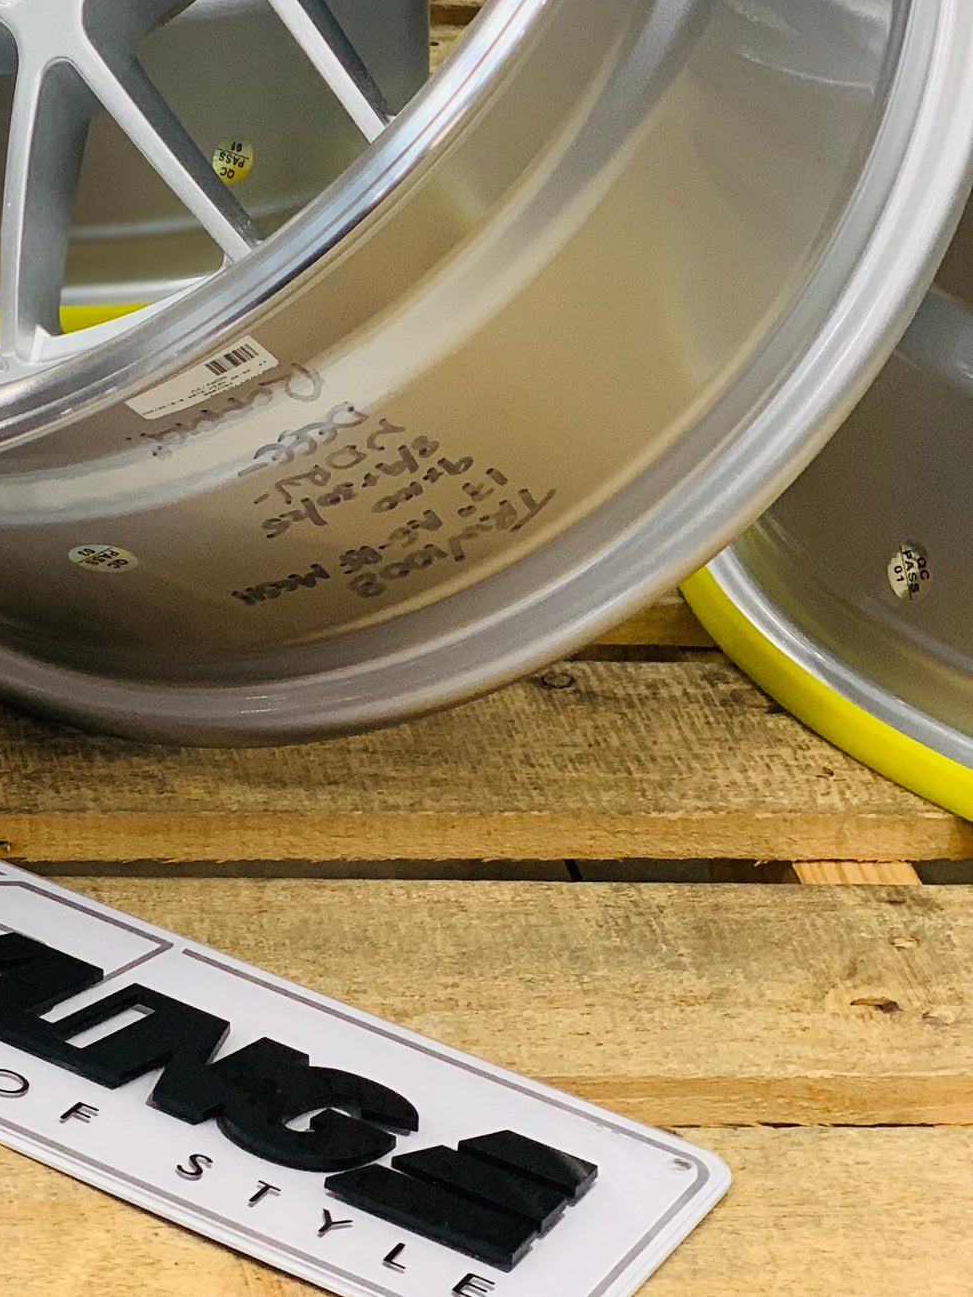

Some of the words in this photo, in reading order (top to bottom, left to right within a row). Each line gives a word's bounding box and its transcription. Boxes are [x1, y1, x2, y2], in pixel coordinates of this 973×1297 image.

[218, 151, 246, 168] PASS
[219, 166, 235, 179] QC
[85, 549, 120, 566] PASS
[107, 558, 129, 569] QC
[893, 565, 905, 582] 01
[902, 549, 920, 593] PASS
[916, 556, 931, 580] QC
[174, 1152, 497, 1297] STYLE
